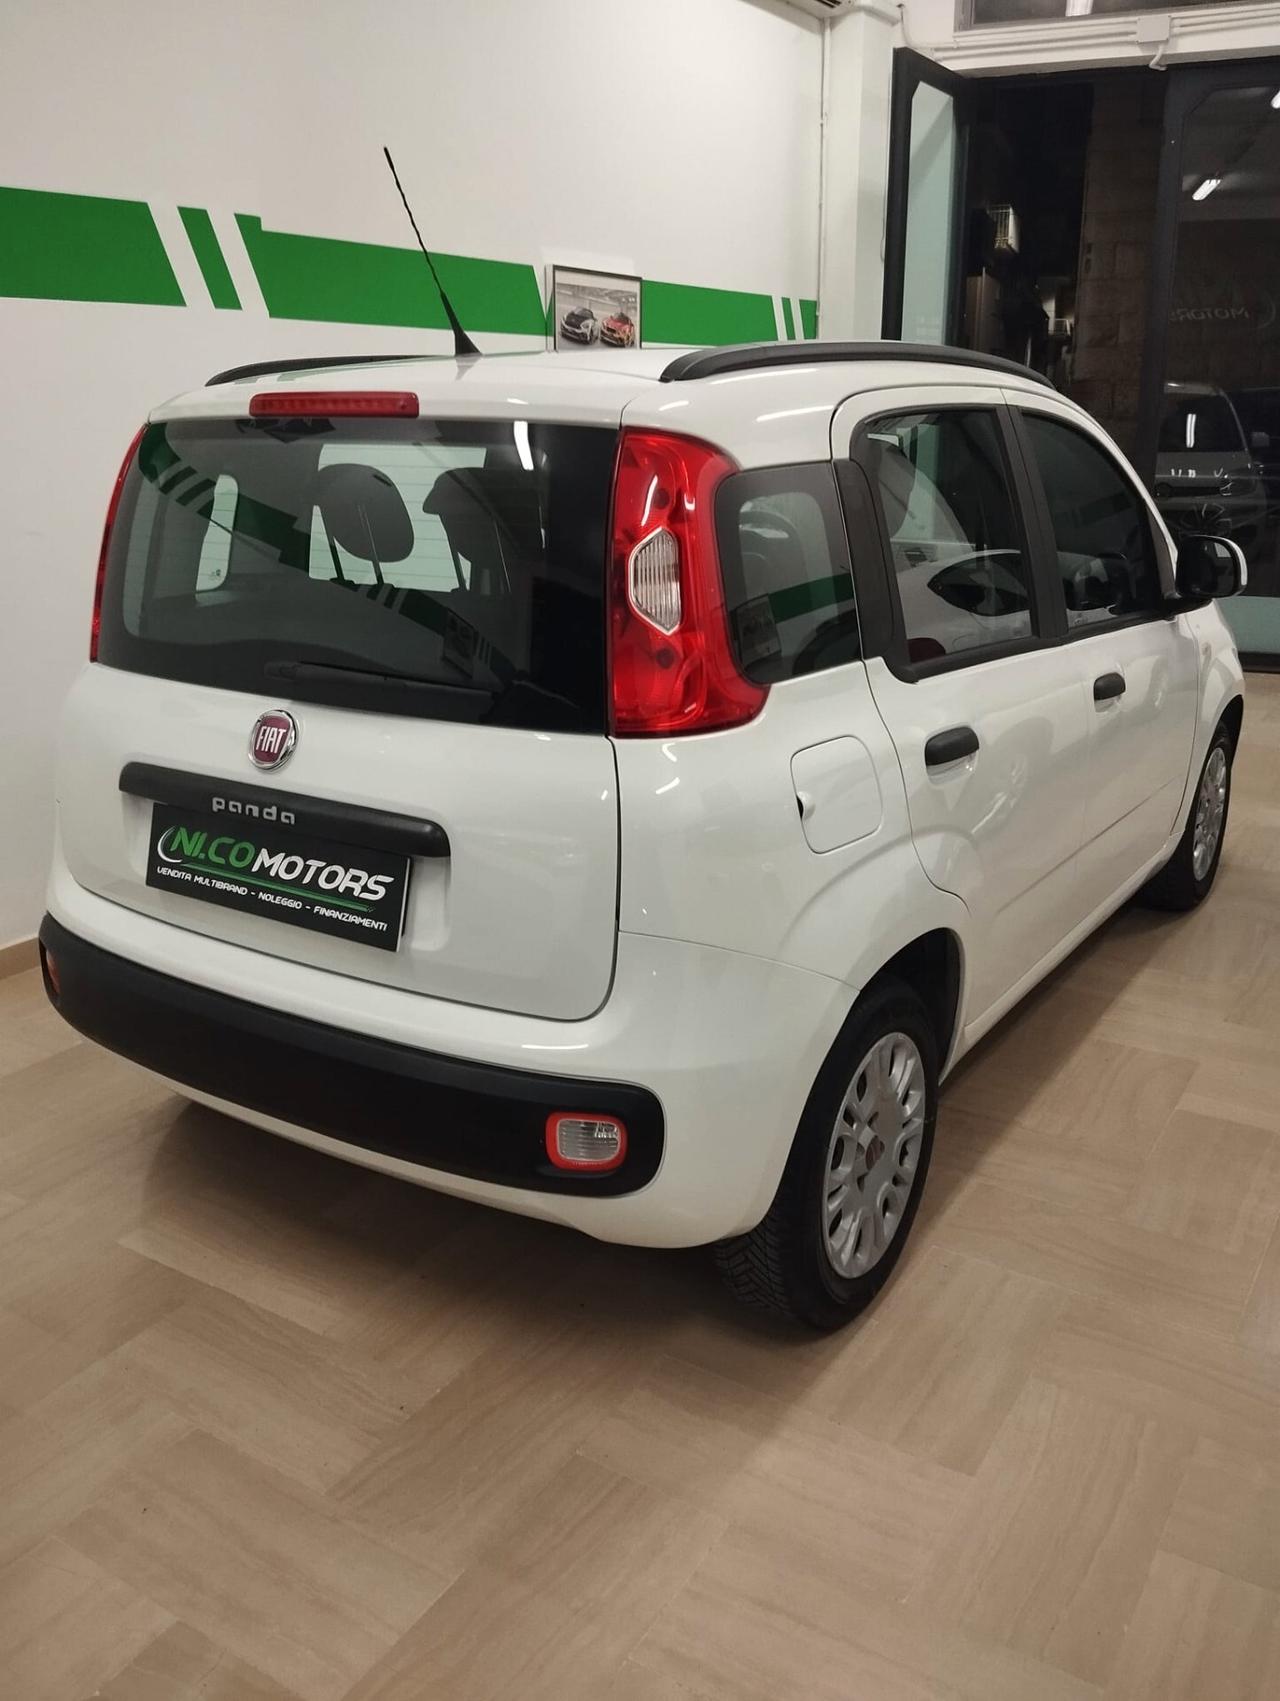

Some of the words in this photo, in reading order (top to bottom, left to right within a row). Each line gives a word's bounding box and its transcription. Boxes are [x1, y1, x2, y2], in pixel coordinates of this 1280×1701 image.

[255, 725, 287, 754] FIAT
[212, 797, 295, 825] panda
[157, 866, 192, 881] VENDITA
[193, 875, 248, 896] MULTIBRAND
[258, 891, 303, 910] NOLEGGIO
[313, 905, 388, 932] FINANZIAMENTI
